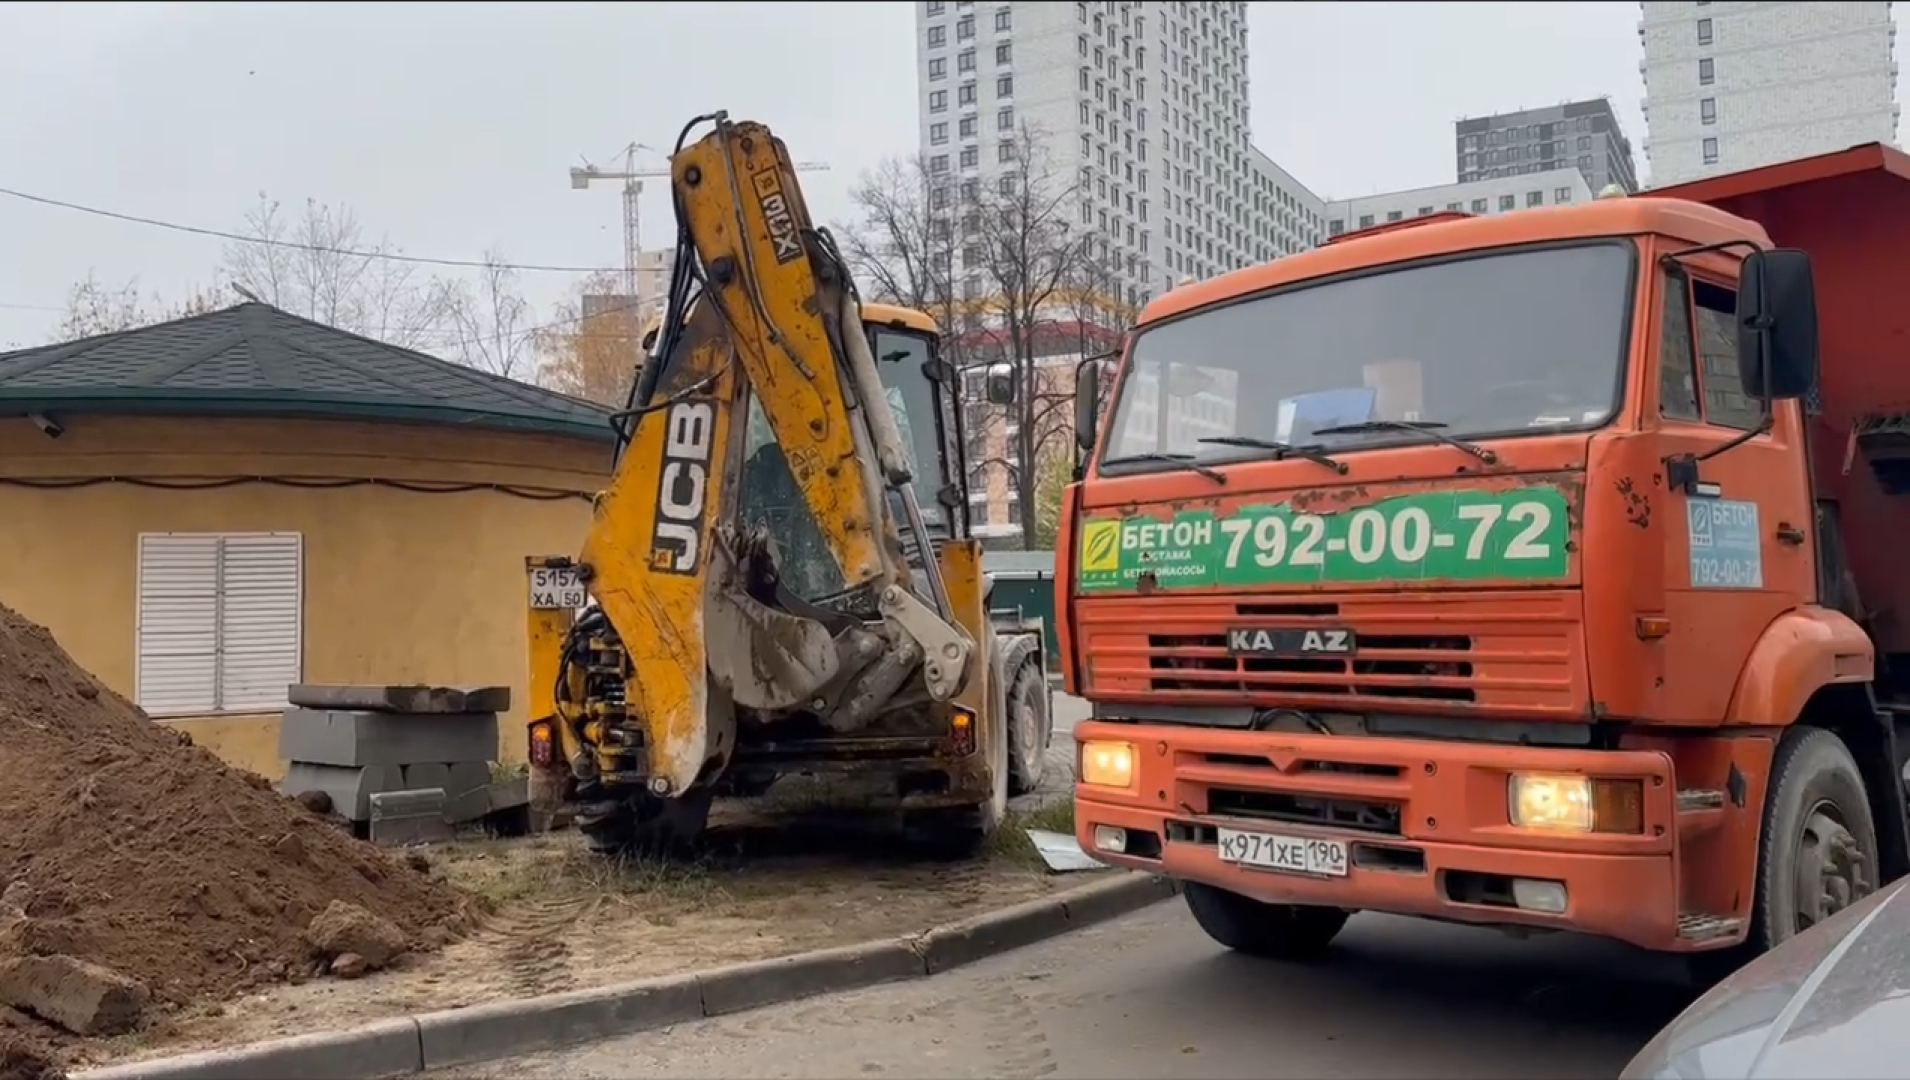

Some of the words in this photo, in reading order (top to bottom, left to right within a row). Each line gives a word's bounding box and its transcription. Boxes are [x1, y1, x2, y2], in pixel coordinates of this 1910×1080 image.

[657, 402, 713, 571] JCB
[1122, 519, 1213, 549] БЕТОН
[1220, 501, 1552, 569] 792-00-72
[536, 569, 578, 587] 5157
[1123, 565, 1206, 578] БЕТОНАСОСЫ
[564, 592, 581, 606] 50
